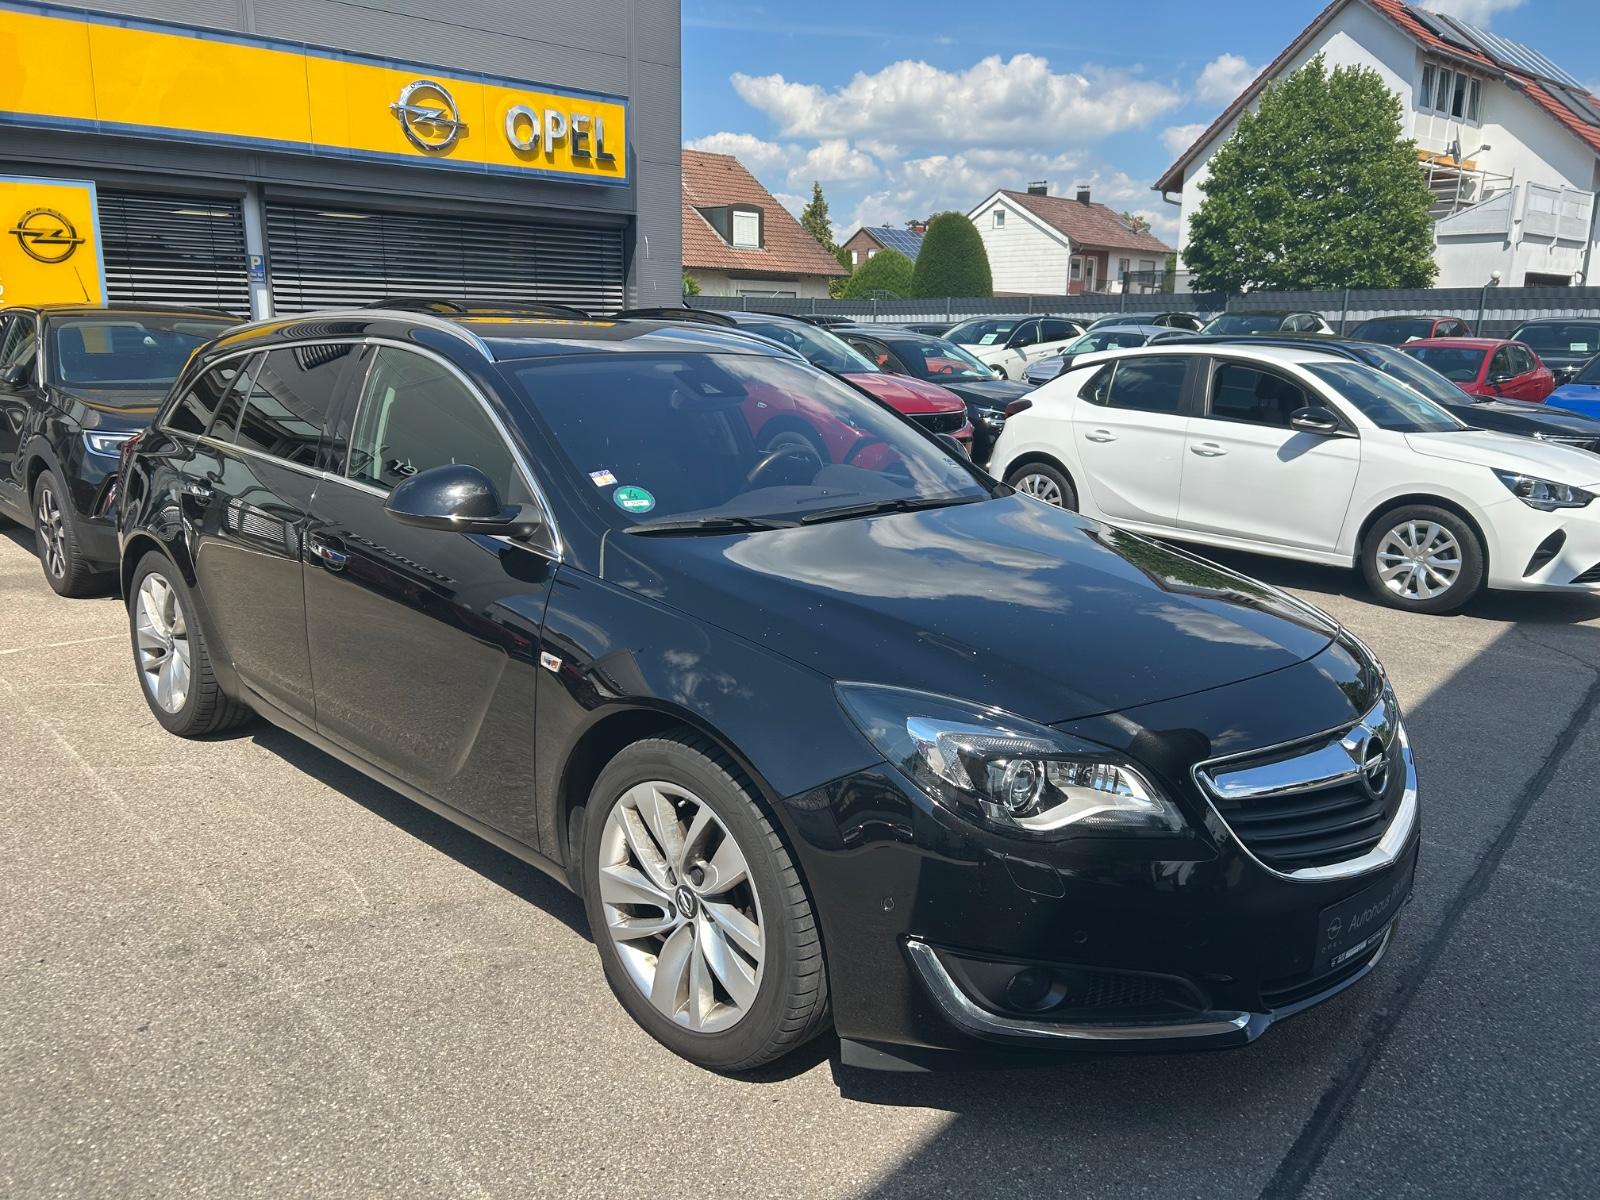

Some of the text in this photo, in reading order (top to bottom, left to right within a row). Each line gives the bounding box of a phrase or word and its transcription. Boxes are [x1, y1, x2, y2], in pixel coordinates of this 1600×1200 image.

[505, 104, 616, 162] OPEL
[250, 255, 261, 269] P
[628, 489, 639, 500] 4
